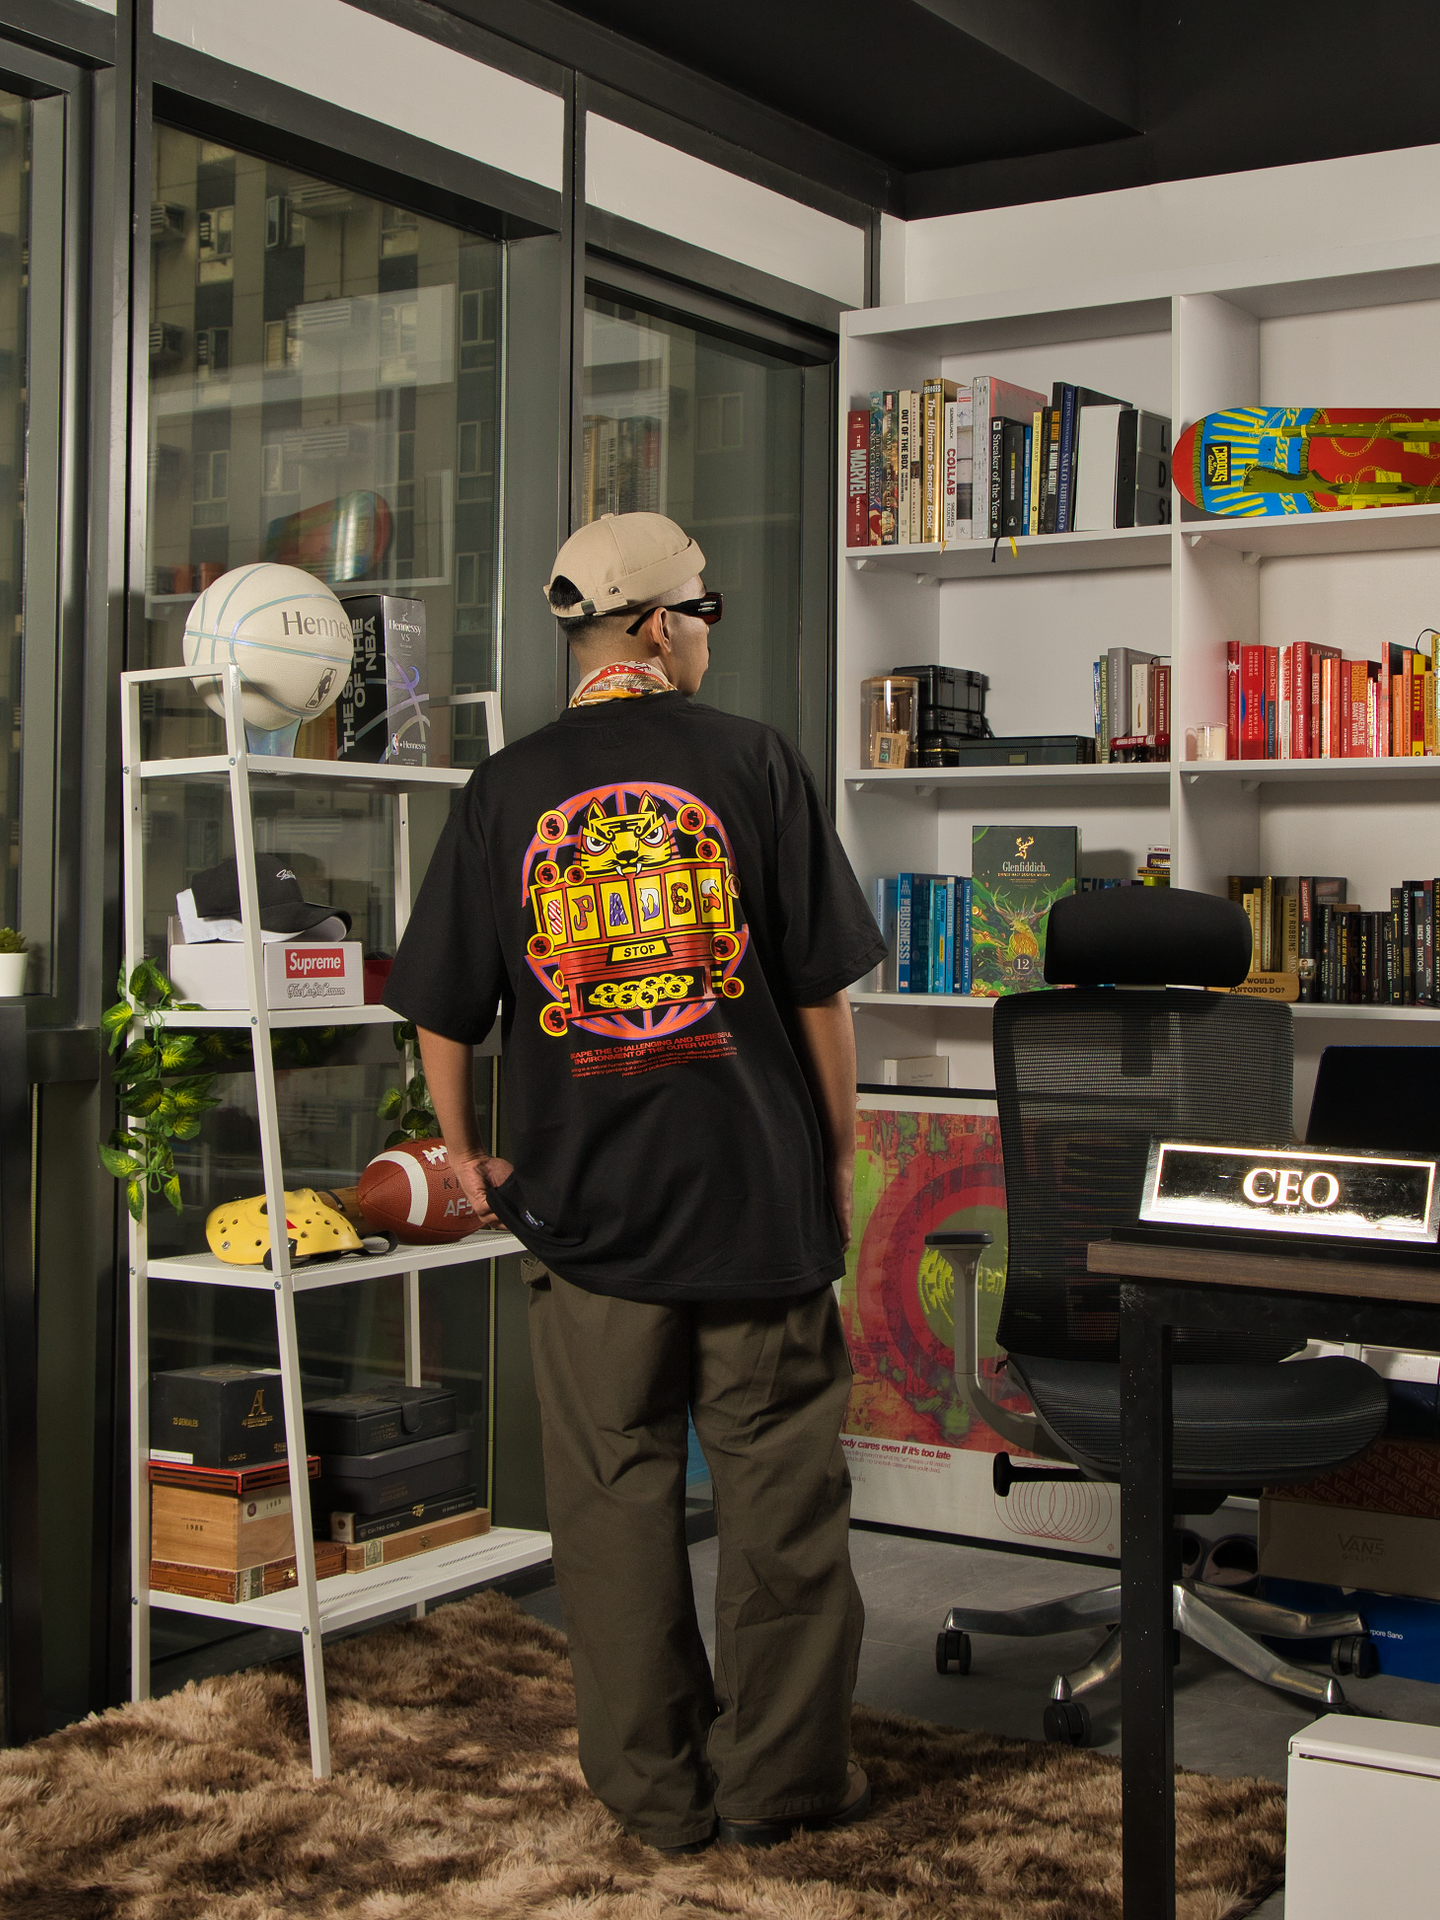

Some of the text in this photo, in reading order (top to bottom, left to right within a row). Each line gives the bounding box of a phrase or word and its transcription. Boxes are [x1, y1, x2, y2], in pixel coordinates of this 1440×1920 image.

[901, 409, 909, 470] OUT OF THE BOX
[927, 419, 935, 461] Ultimate
[850, 449, 866, 497] MARVEL
[946, 448, 956, 496] COLLAB
[1211, 446, 1228, 482] CROOKS
[926, 464, 935, 503] Sneaker
[991, 433, 1001, 520] Sneaker of the Year
[1058, 453, 1069, 523] SAULO RIBEIRO
[926, 505, 934, 529] Book
[388, 619, 421, 636] Hennessy
[364, 616, 377, 671] NBA
[352, 618, 366, 708] OF THE
[1296, 663, 1302, 672] OF
[1351, 666, 1359, 701] ROBBINS
[1358, 665, 1366, 701] ANTHONY
[343, 703, 354, 752] THE
[402, 741, 426, 753] Hennessy
[1003, 861, 1047, 872] Glenfiddich
[1435, 909, 1440, 917] OF
[900, 906, 910, 960] BUSINESS
[624, 945, 656, 957] STOP
[290, 952, 341, 975] Supreme
[1017, 959, 1030, 969] 12
[594, 1047, 612, 1056] THE
[613, 1040, 672, 1053] CHALLENGING
[673, 1036, 693, 1045] AND
[635, 1049, 646, 1057] OF
[647, 1046, 665, 1055] THE
[666, 1042, 697, 1051] OUTER
[1243, 1168, 1339, 1207] CEO
[858, 1441, 879, 1450] cares
[881, 1444, 900, 1454] even
[901, 1445, 907, 1454] if
[908, 1446, 919, 1456] it's
[922, 1449, 934, 1458] too
[936, 1450, 951, 1460] late
[1367, 1450, 1393, 1474] VANS
[1388, 1447, 1414, 1471] VANS
[1335, 1477, 1361, 1501] VANS
[1355, 1473, 1381, 1498] VANS
[1375, 1471, 1401, 1495] VANS
[1396, 1468, 1422, 1492] VANS
[266, 1499, 282, 1510] 1988
[1405, 1489, 1431, 1513] VANS
[1338, 1534, 1385, 1556] VANS
